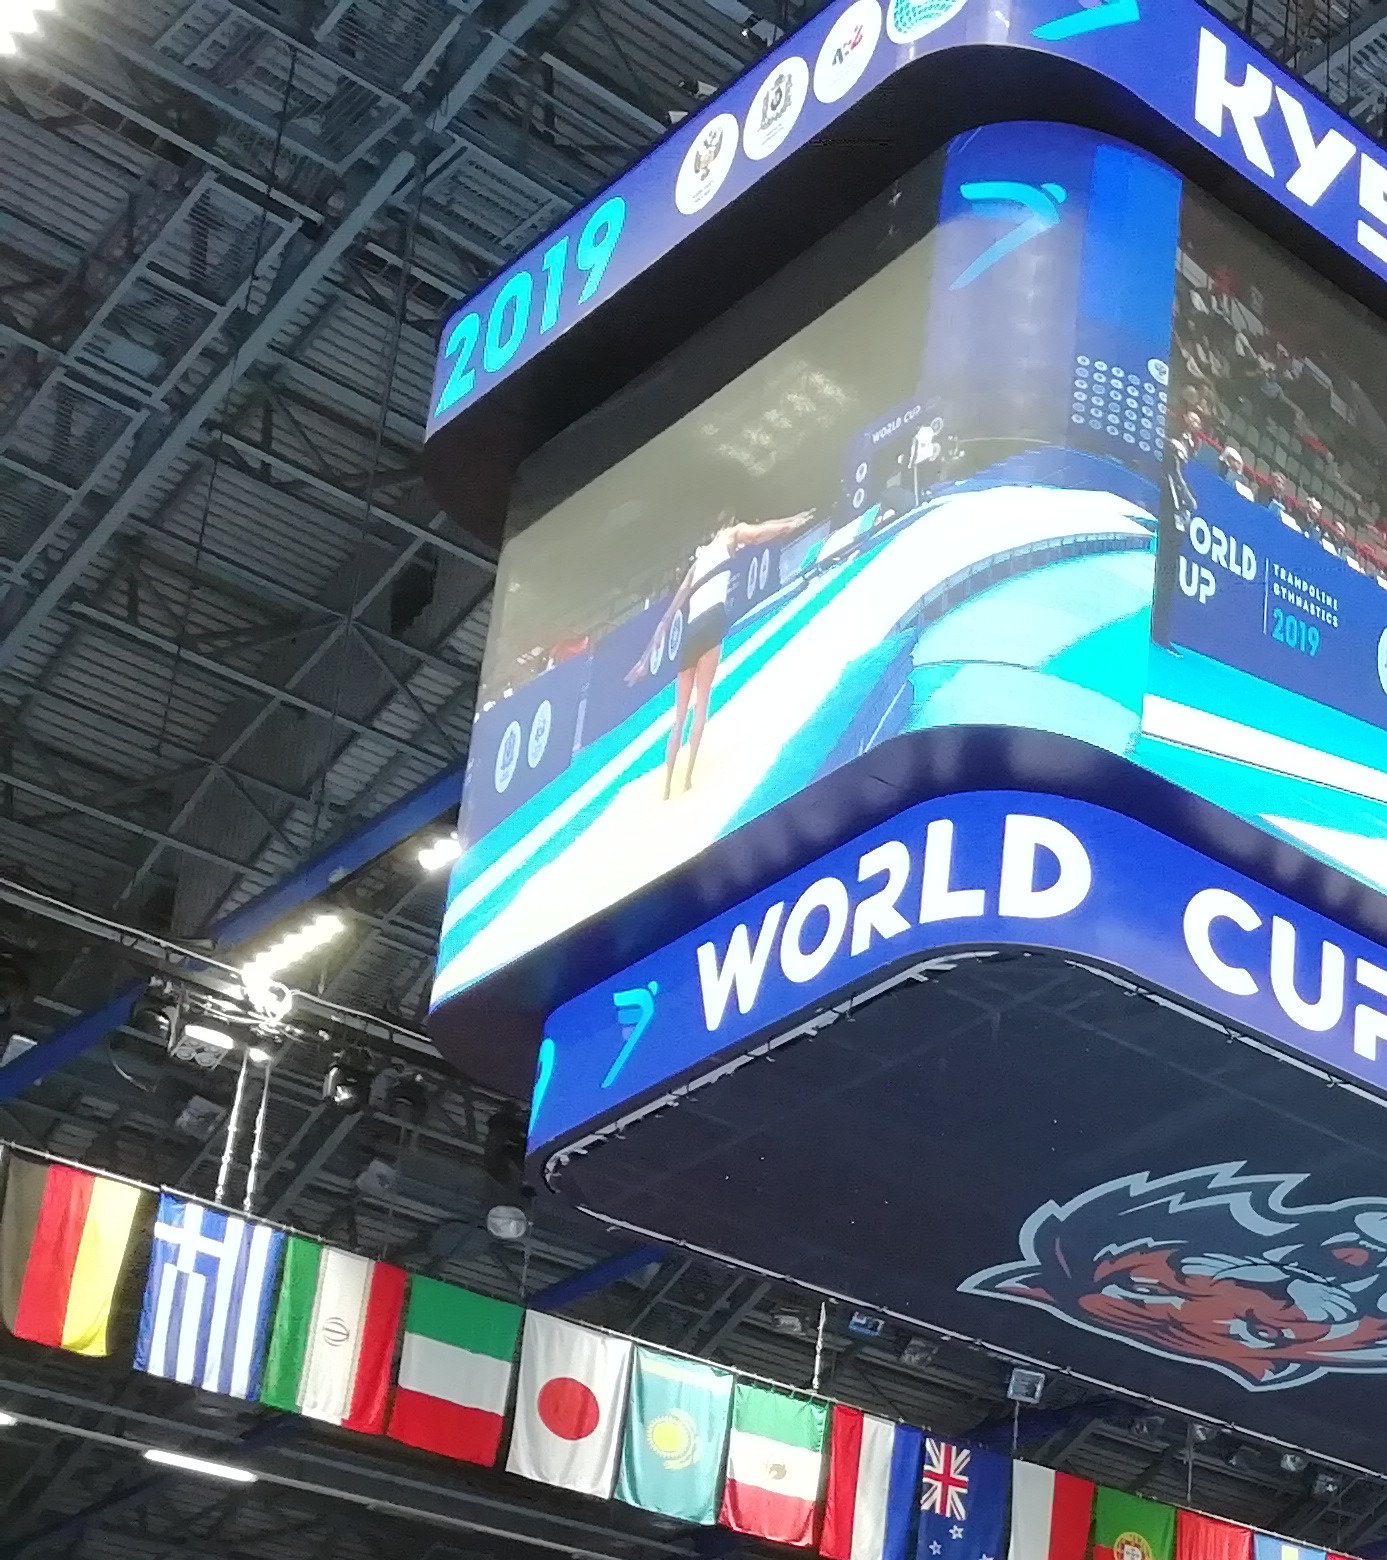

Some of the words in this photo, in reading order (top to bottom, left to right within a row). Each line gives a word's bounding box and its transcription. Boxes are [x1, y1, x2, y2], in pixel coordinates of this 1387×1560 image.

[435, 197, 627, 416] 2019
[1179, 555, 1217, 605] UP
[1190, 516, 1257, 581] ORLD
[1271, 607, 1320, 657] 2019
[697, 814, 1093, 1032] WORLD
